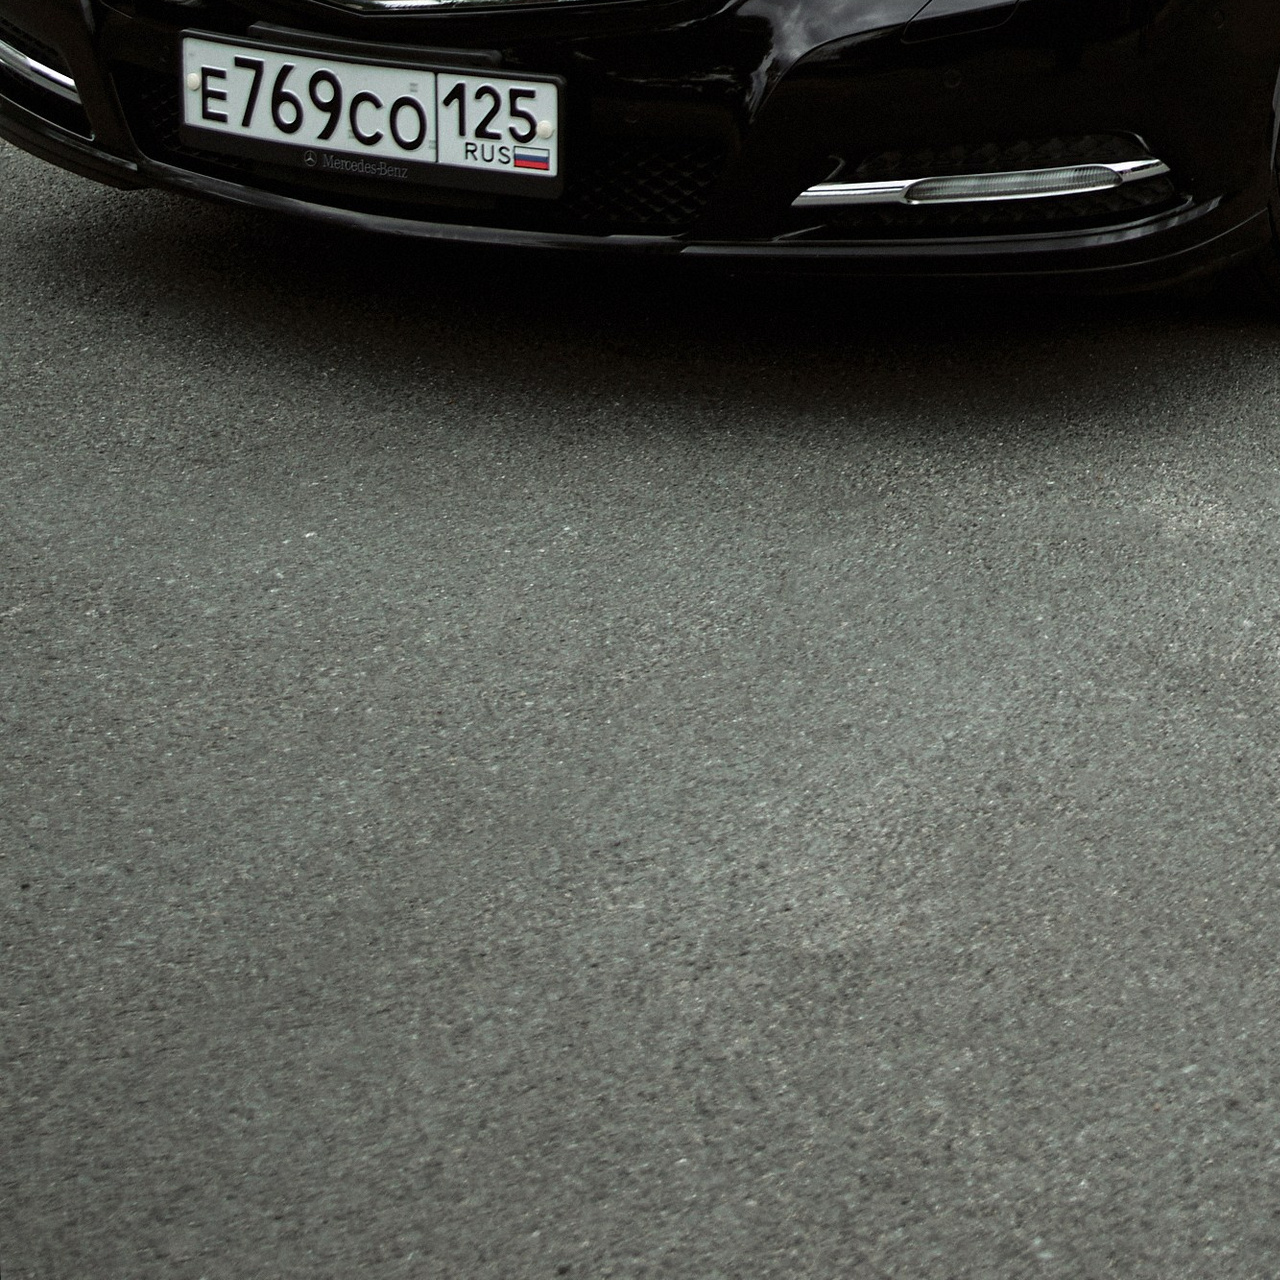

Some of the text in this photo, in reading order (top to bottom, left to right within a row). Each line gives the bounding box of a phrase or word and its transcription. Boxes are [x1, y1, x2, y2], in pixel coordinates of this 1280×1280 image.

[201, 55, 538, 151] E769CO 125
[322, 153, 408, 179] Mercedes-Benz
[464, 142, 511, 164] RUS
